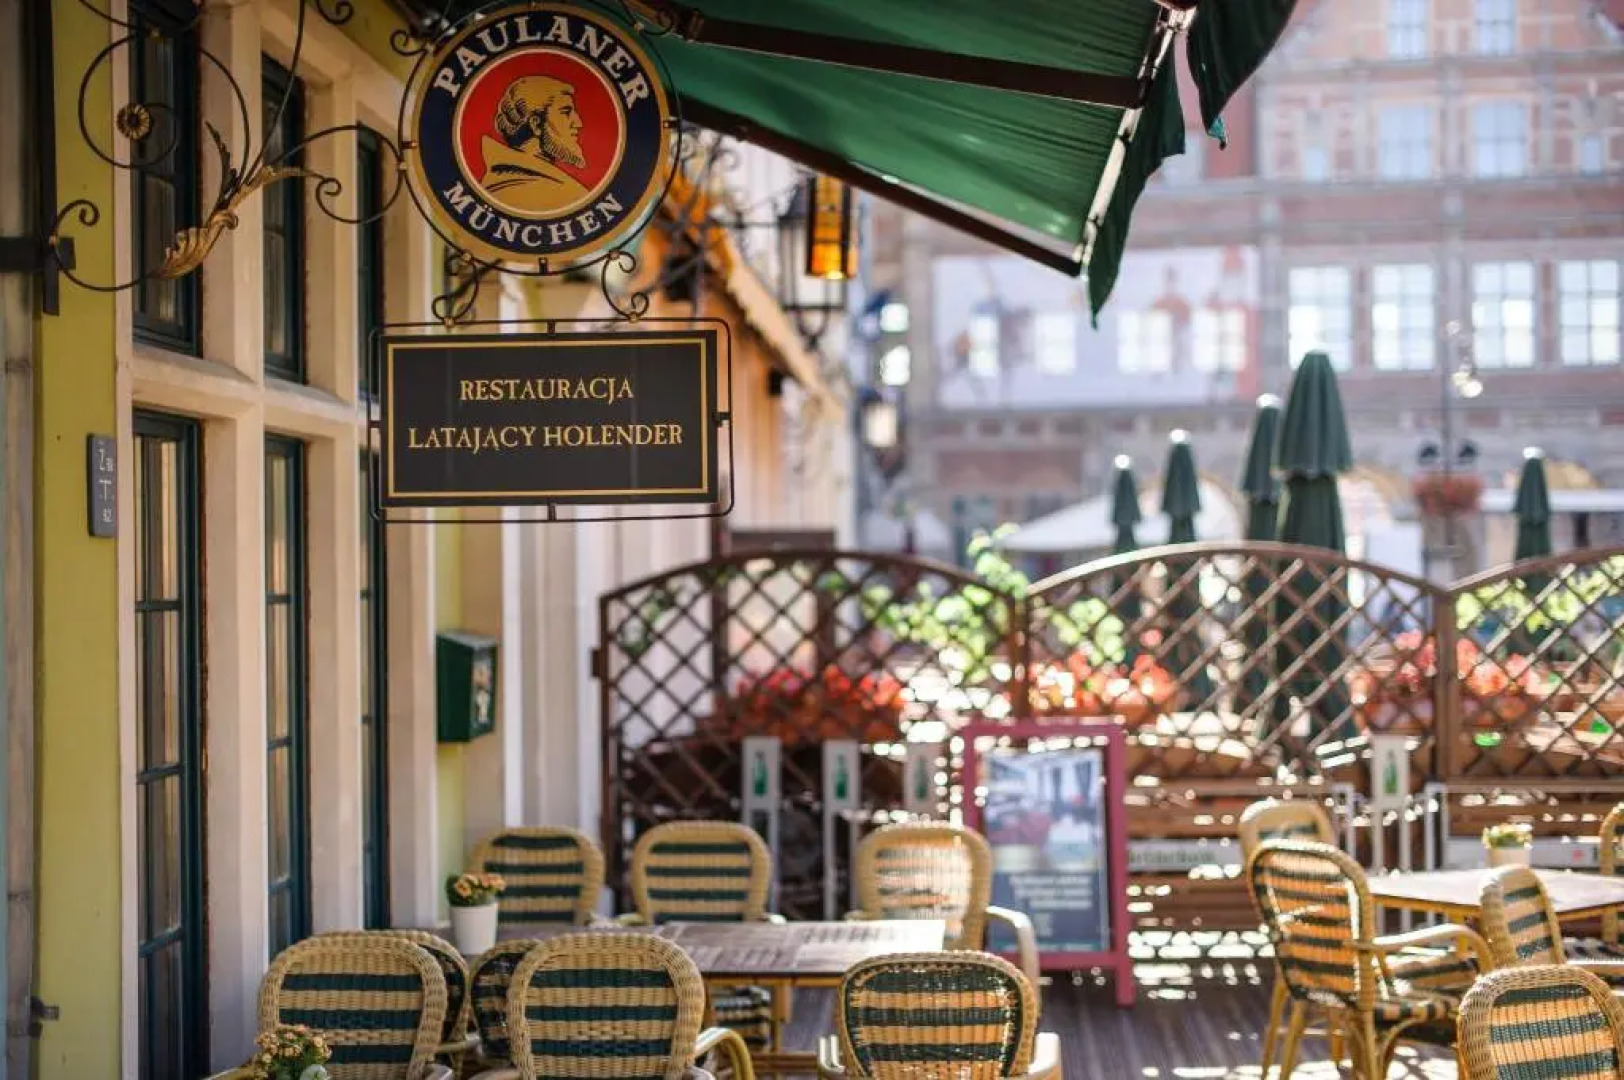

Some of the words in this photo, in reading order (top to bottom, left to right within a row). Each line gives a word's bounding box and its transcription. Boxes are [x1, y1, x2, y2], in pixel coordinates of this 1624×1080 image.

[434, 15, 650, 109] PAULANER
[444, 181, 624, 247] MÜNCHEN
[459, 376, 635, 405] RESTAURACJA
[543, 424, 683, 447] HOLENDER
